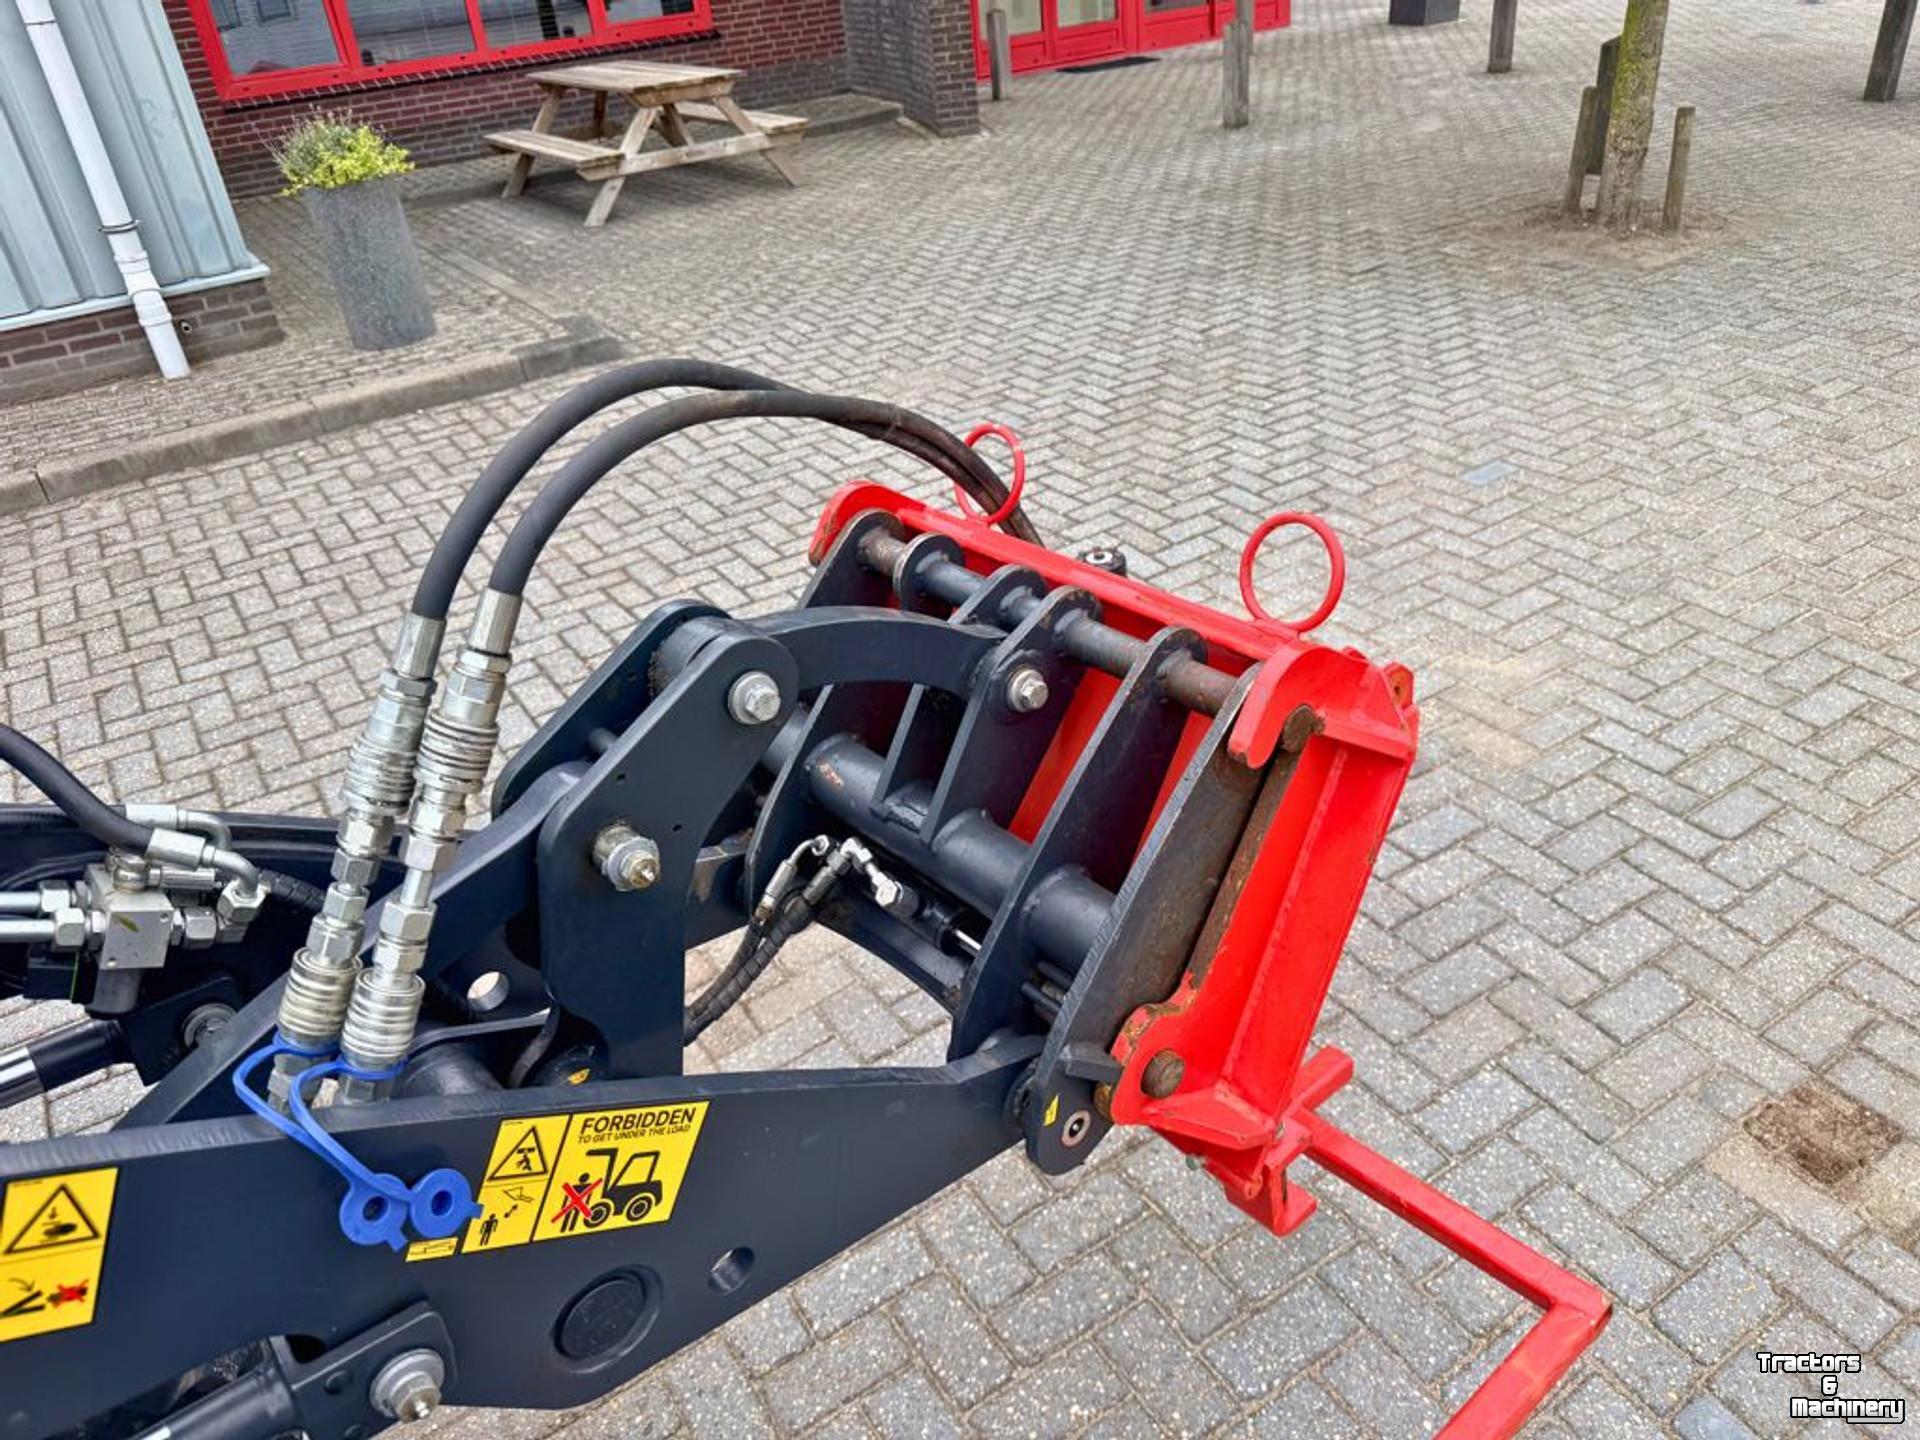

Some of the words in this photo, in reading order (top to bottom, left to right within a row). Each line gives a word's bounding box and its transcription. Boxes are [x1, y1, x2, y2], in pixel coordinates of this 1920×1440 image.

[580, 1107, 697, 1134] FORBIDDEN
[578, 1134, 591, 1144] TO
[592, 1132, 613, 1143] GET
[614, 1129, 646, 1141] UNDER
[648, 1126, 665, 1136] THE
[666, 1124, 691, 1135] LOAD
